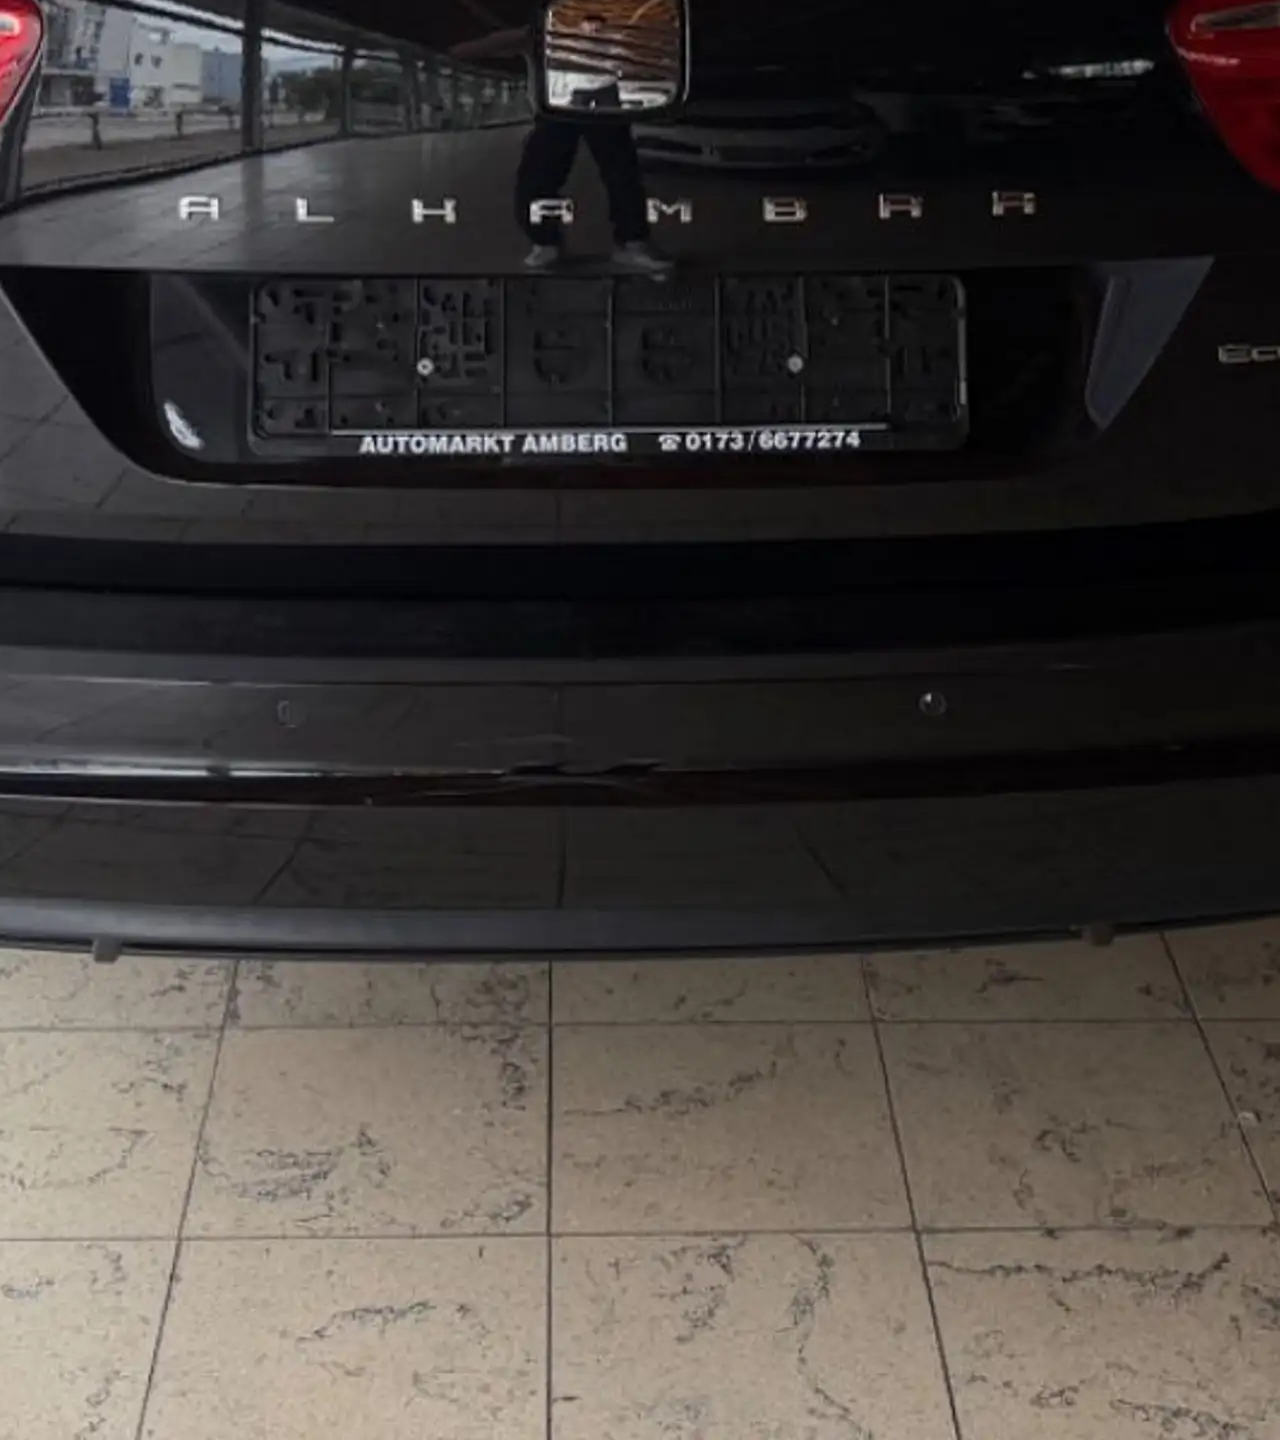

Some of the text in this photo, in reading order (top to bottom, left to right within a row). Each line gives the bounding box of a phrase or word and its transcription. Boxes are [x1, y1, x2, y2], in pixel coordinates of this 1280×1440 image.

[179, 191, 1037, 224] ALHAMBRA
[359, 433, 516, 455] AUTOMARKT
[521, 432, 628, 454] AMBERG
